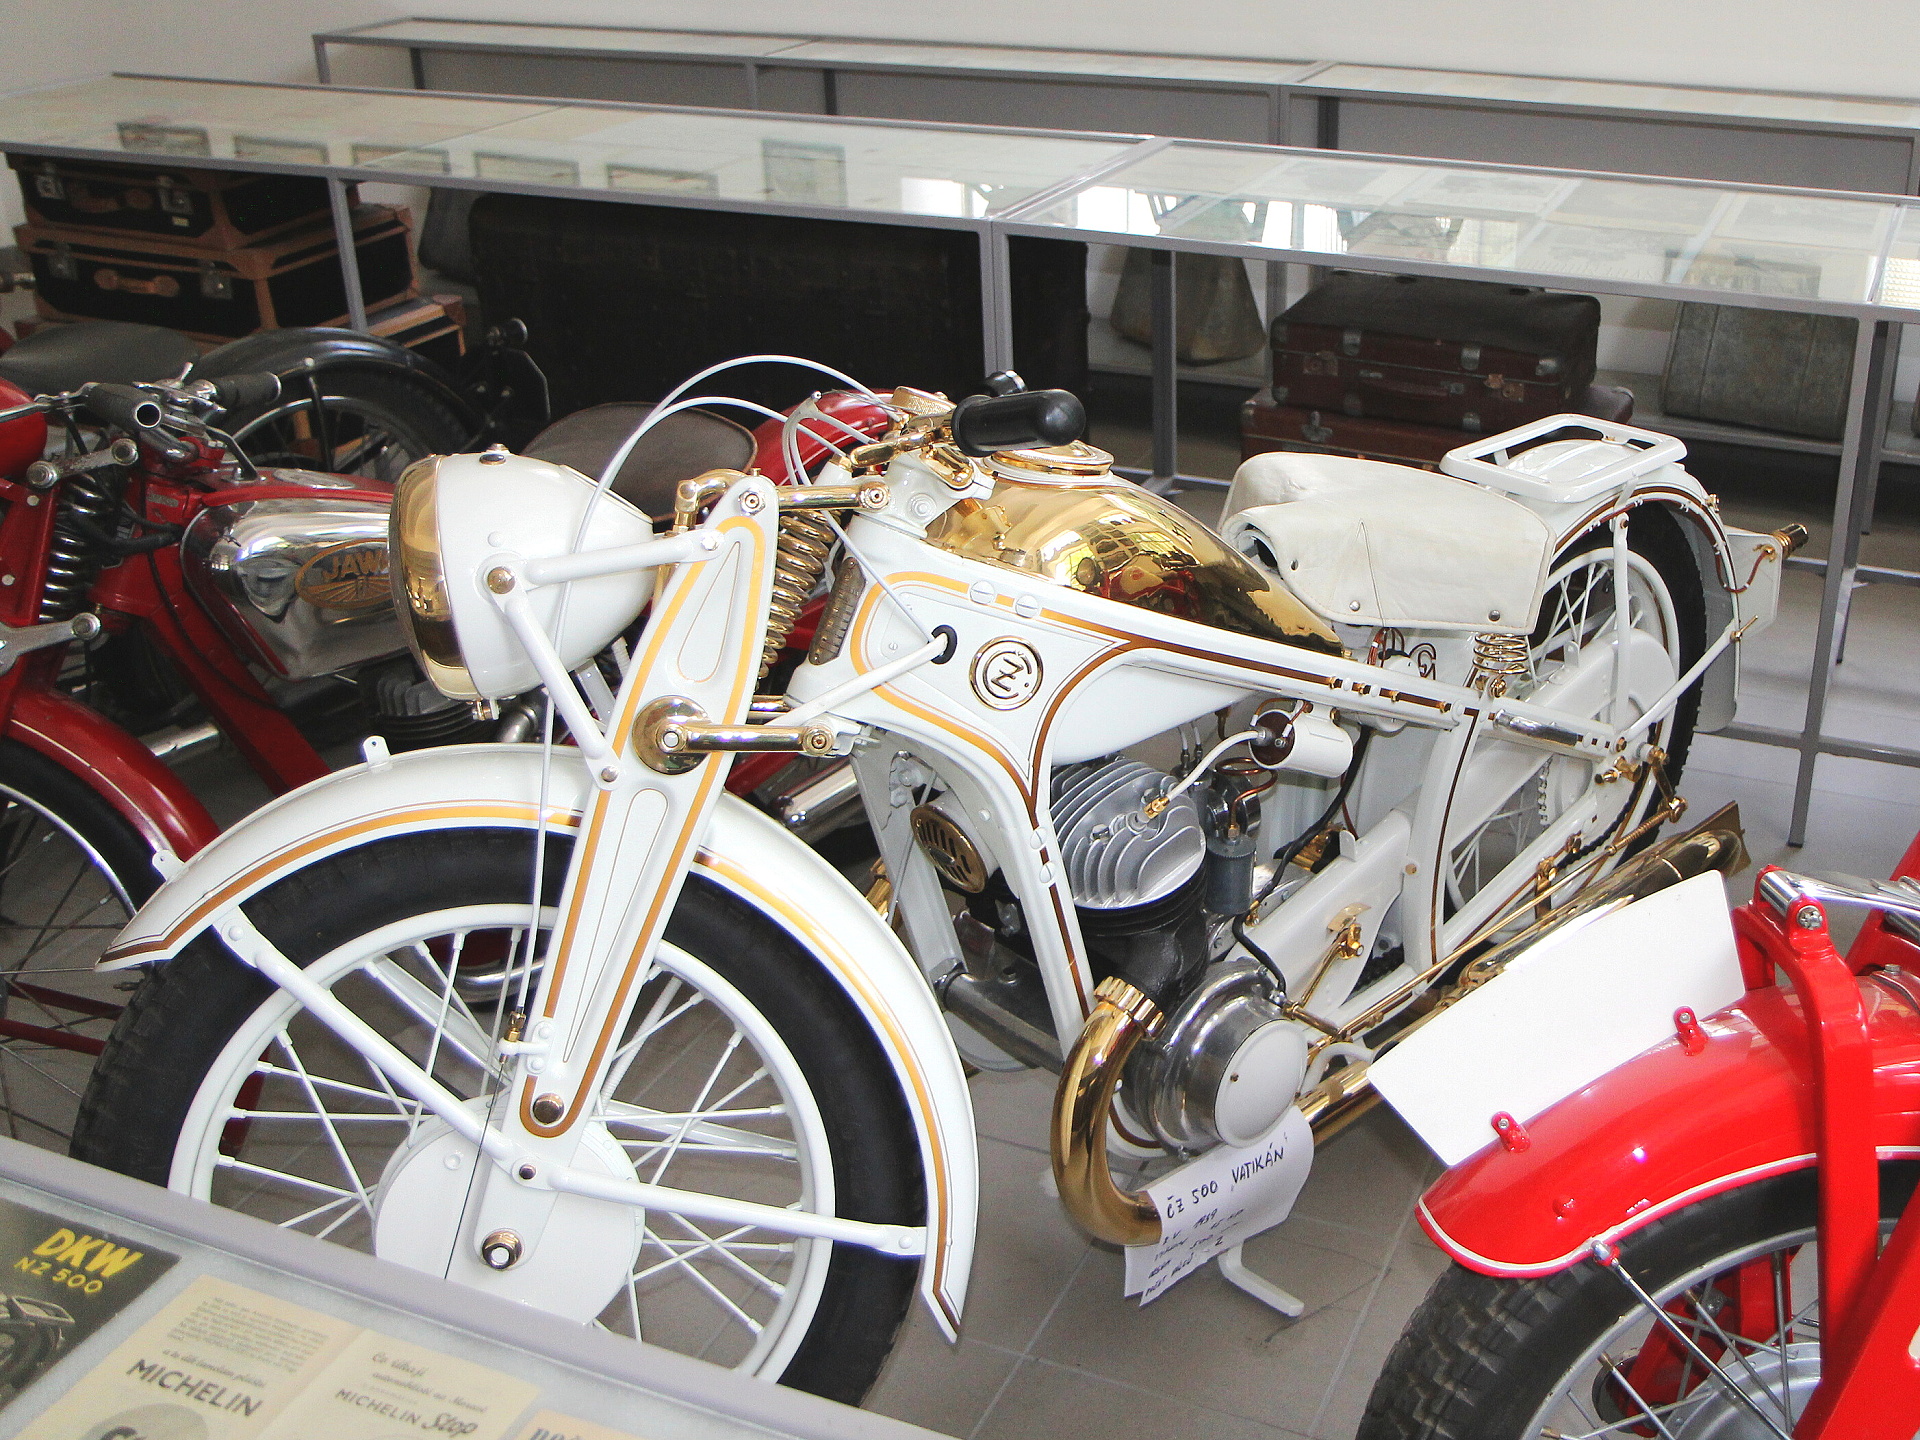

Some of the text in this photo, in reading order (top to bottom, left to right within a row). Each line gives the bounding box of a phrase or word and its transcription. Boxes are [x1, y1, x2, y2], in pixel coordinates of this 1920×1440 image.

[1191, 1180, 1218, 1204] 500
[13, 1256, 104, 1294] NZ 500
[32, 1228, 144, 1277] DKW
[126, 1358, 263, 1417] MICHELIN
[335, 1388, 421, 1425] MICHELIN
[421, 1411, 479, 1438] Stop
